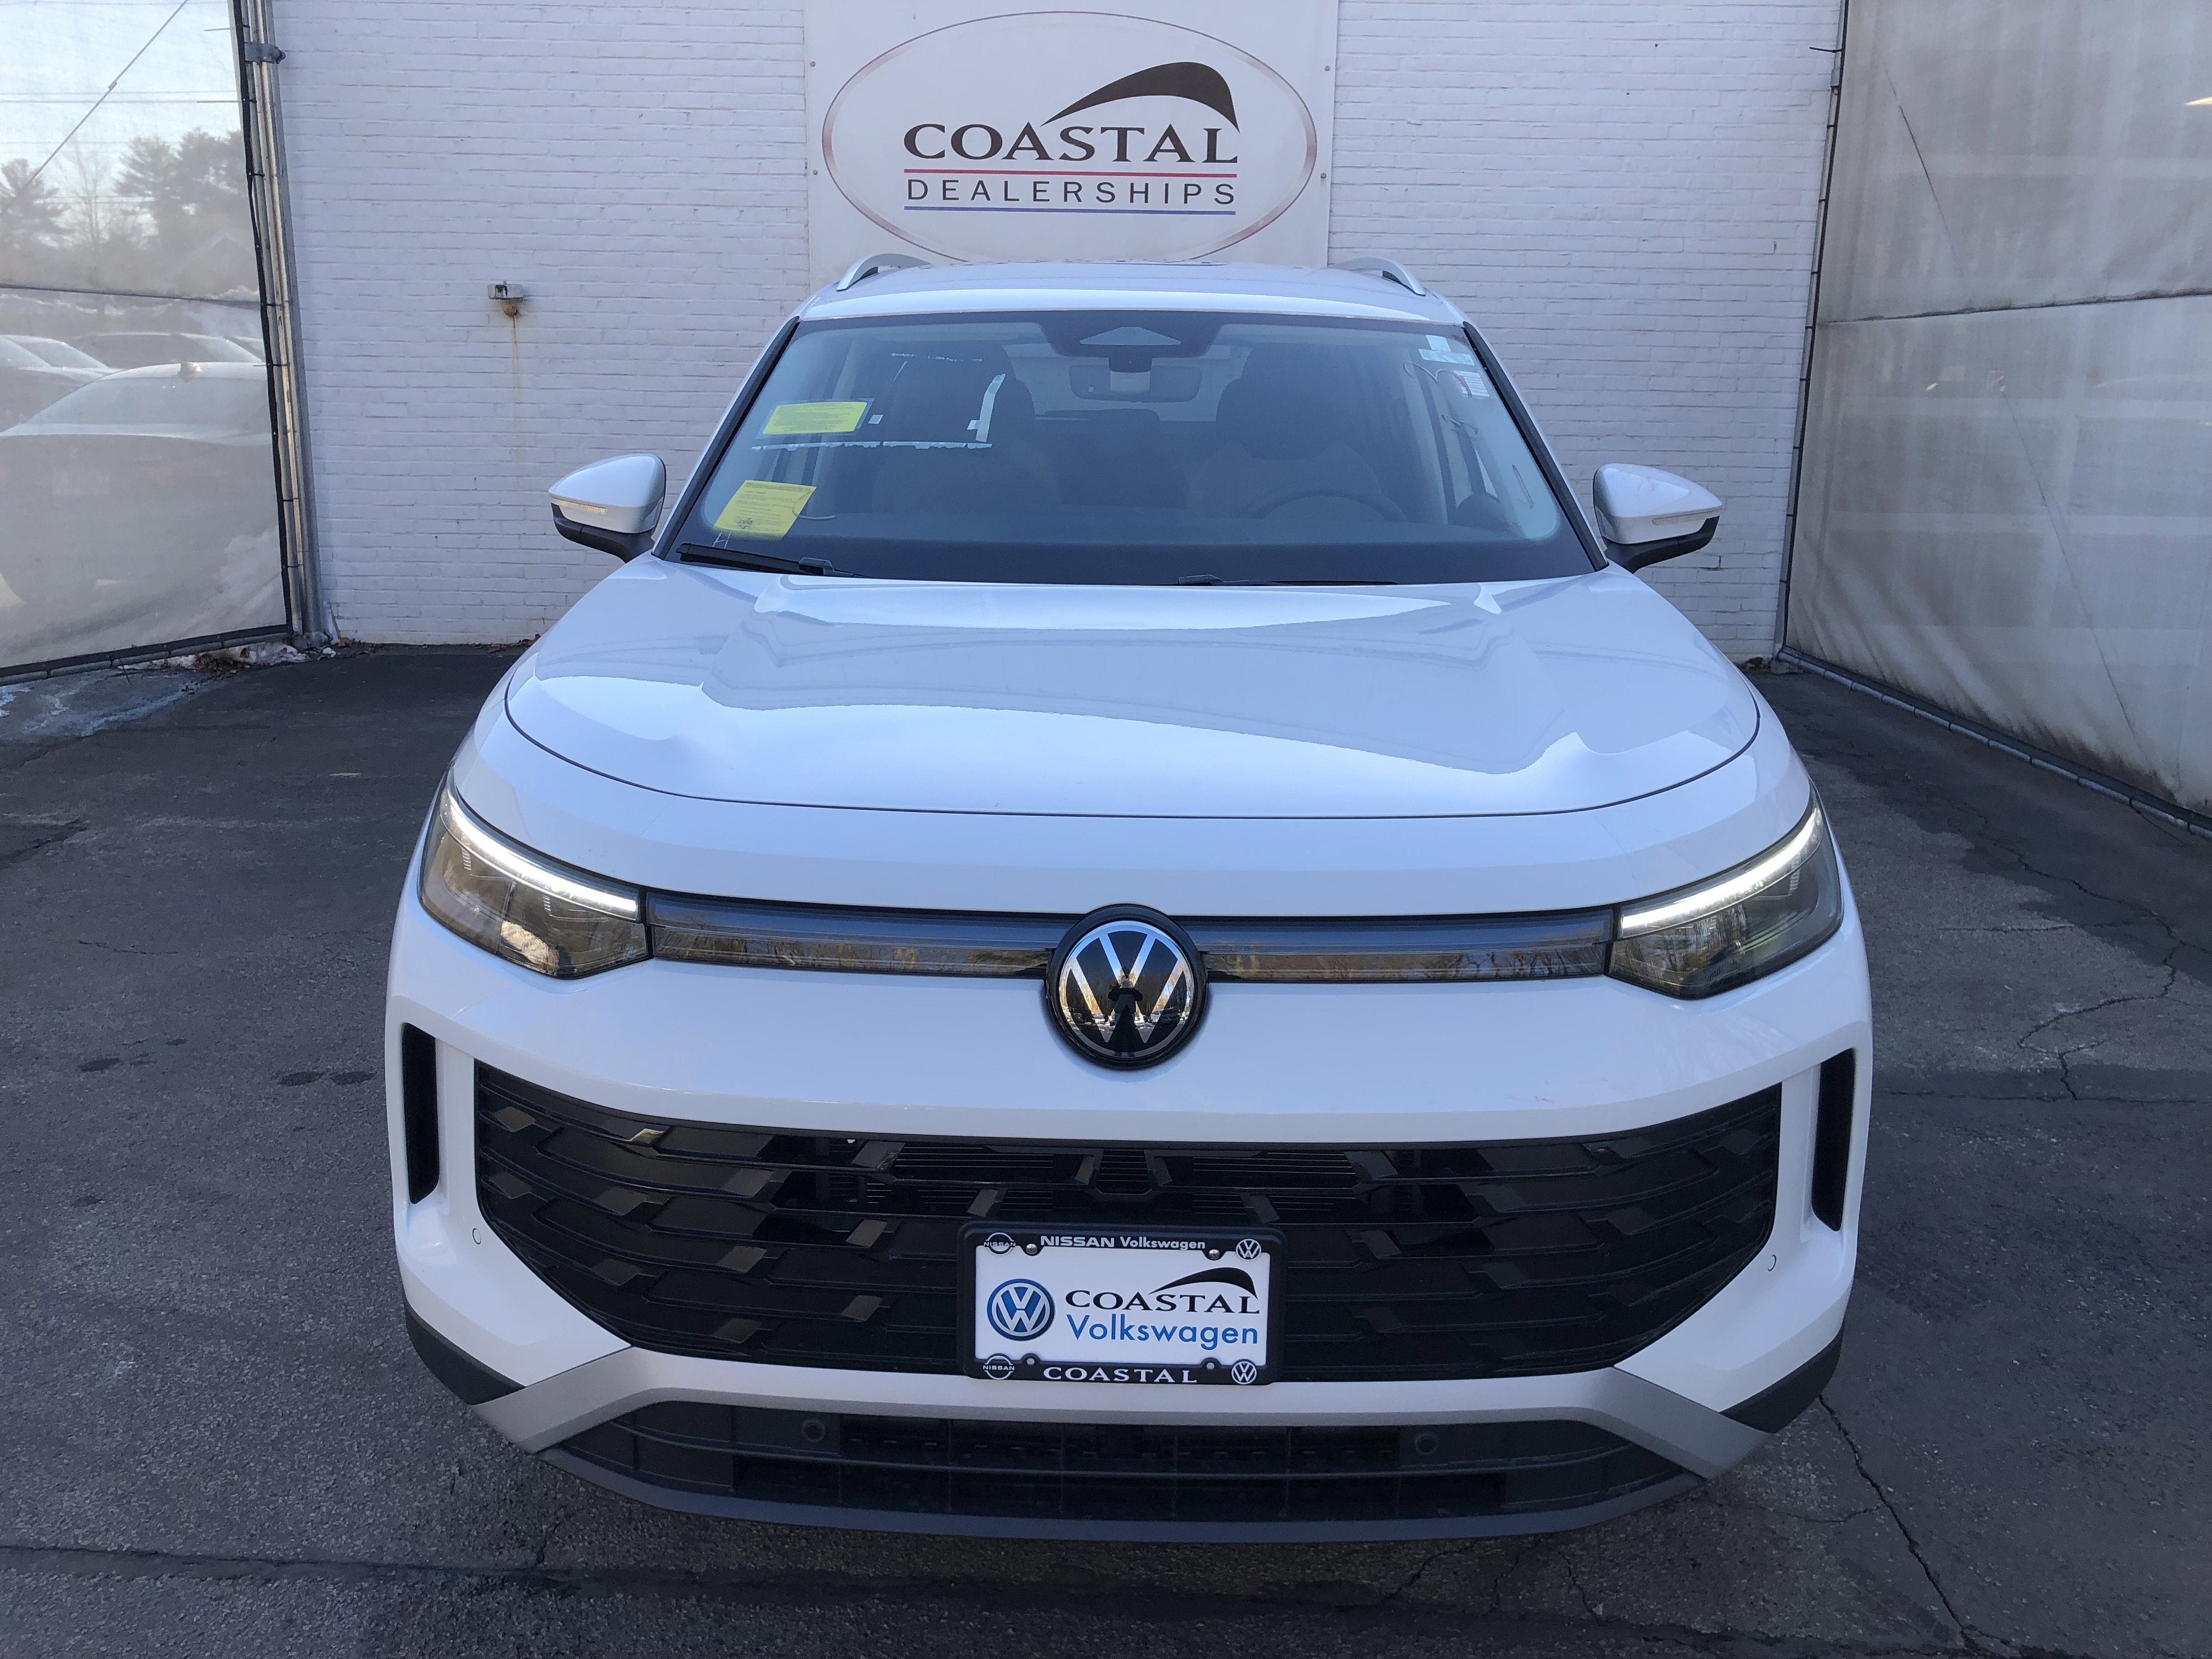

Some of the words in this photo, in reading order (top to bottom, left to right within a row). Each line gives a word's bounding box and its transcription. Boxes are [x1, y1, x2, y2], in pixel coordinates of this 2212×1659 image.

[904, 121, 1238, 163] COASTAL
[908, 179, 1234, 205] DEALERSHIPS
[1041, 1236, 1114, 1247] NISSAN
[1120, 1236, 1206, 1251] Volkswagen
[1065, 1289, 1260, 1314] COASTAL
[1066, 1313, 1258, 1351] Volkswagen
[1043, 1367, 1197, 1383] COASTAL
